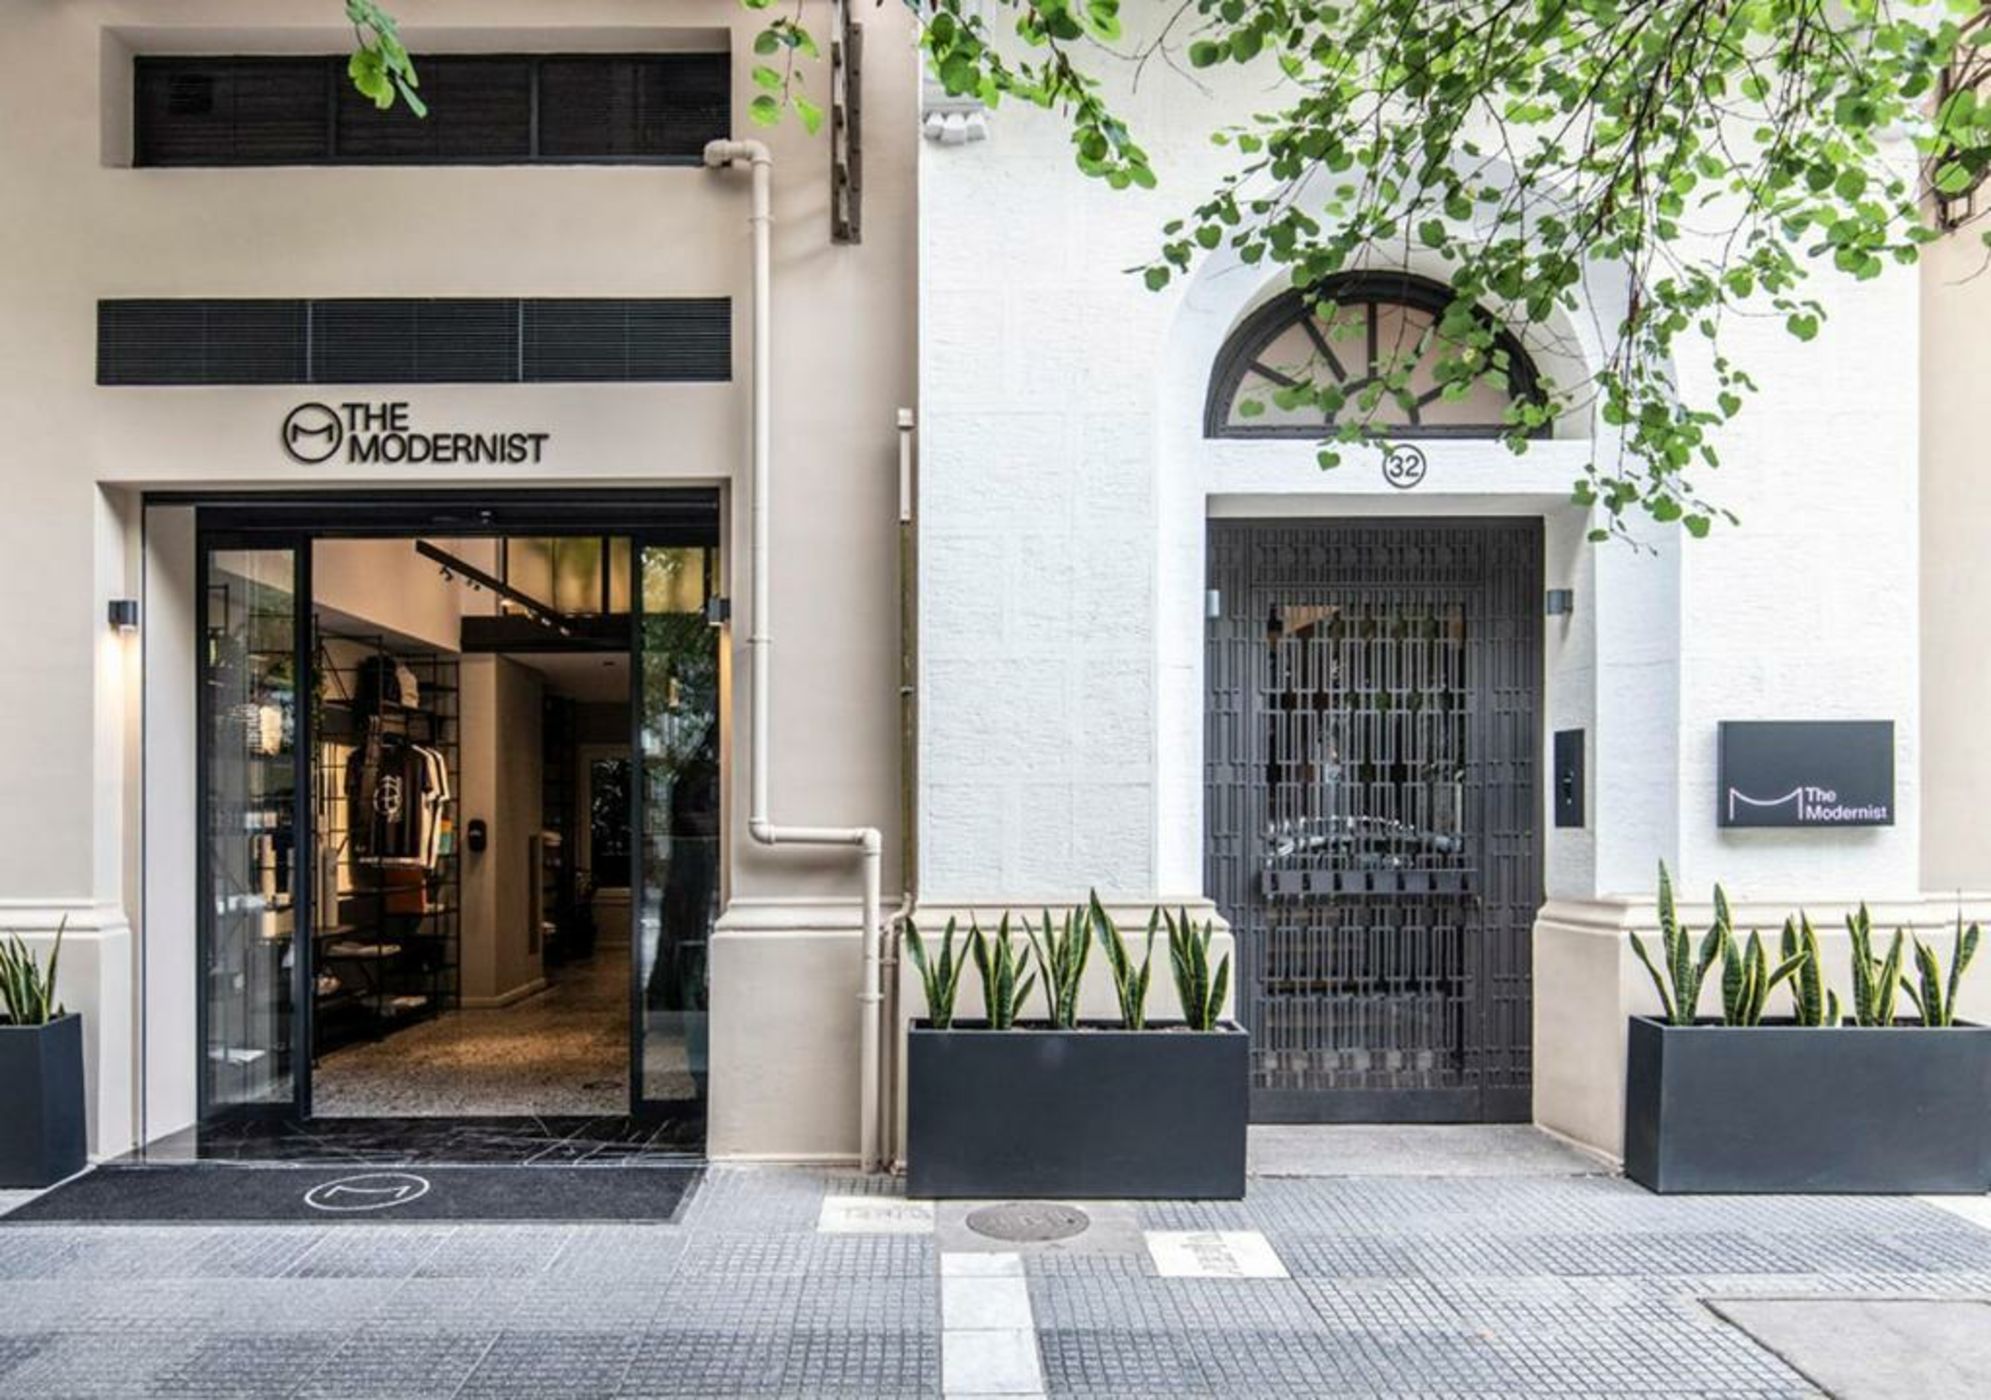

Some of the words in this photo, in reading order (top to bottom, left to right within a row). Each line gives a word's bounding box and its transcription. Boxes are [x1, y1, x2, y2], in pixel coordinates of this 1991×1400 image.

[342, 402, 409, 431] THE
[349, 433, 549, 463] MODERNIST
[1390, 455, 1420, 478] 32
[1804, 787, 1837, 803] The
[1805, 805, 1888, 821] Modernist
